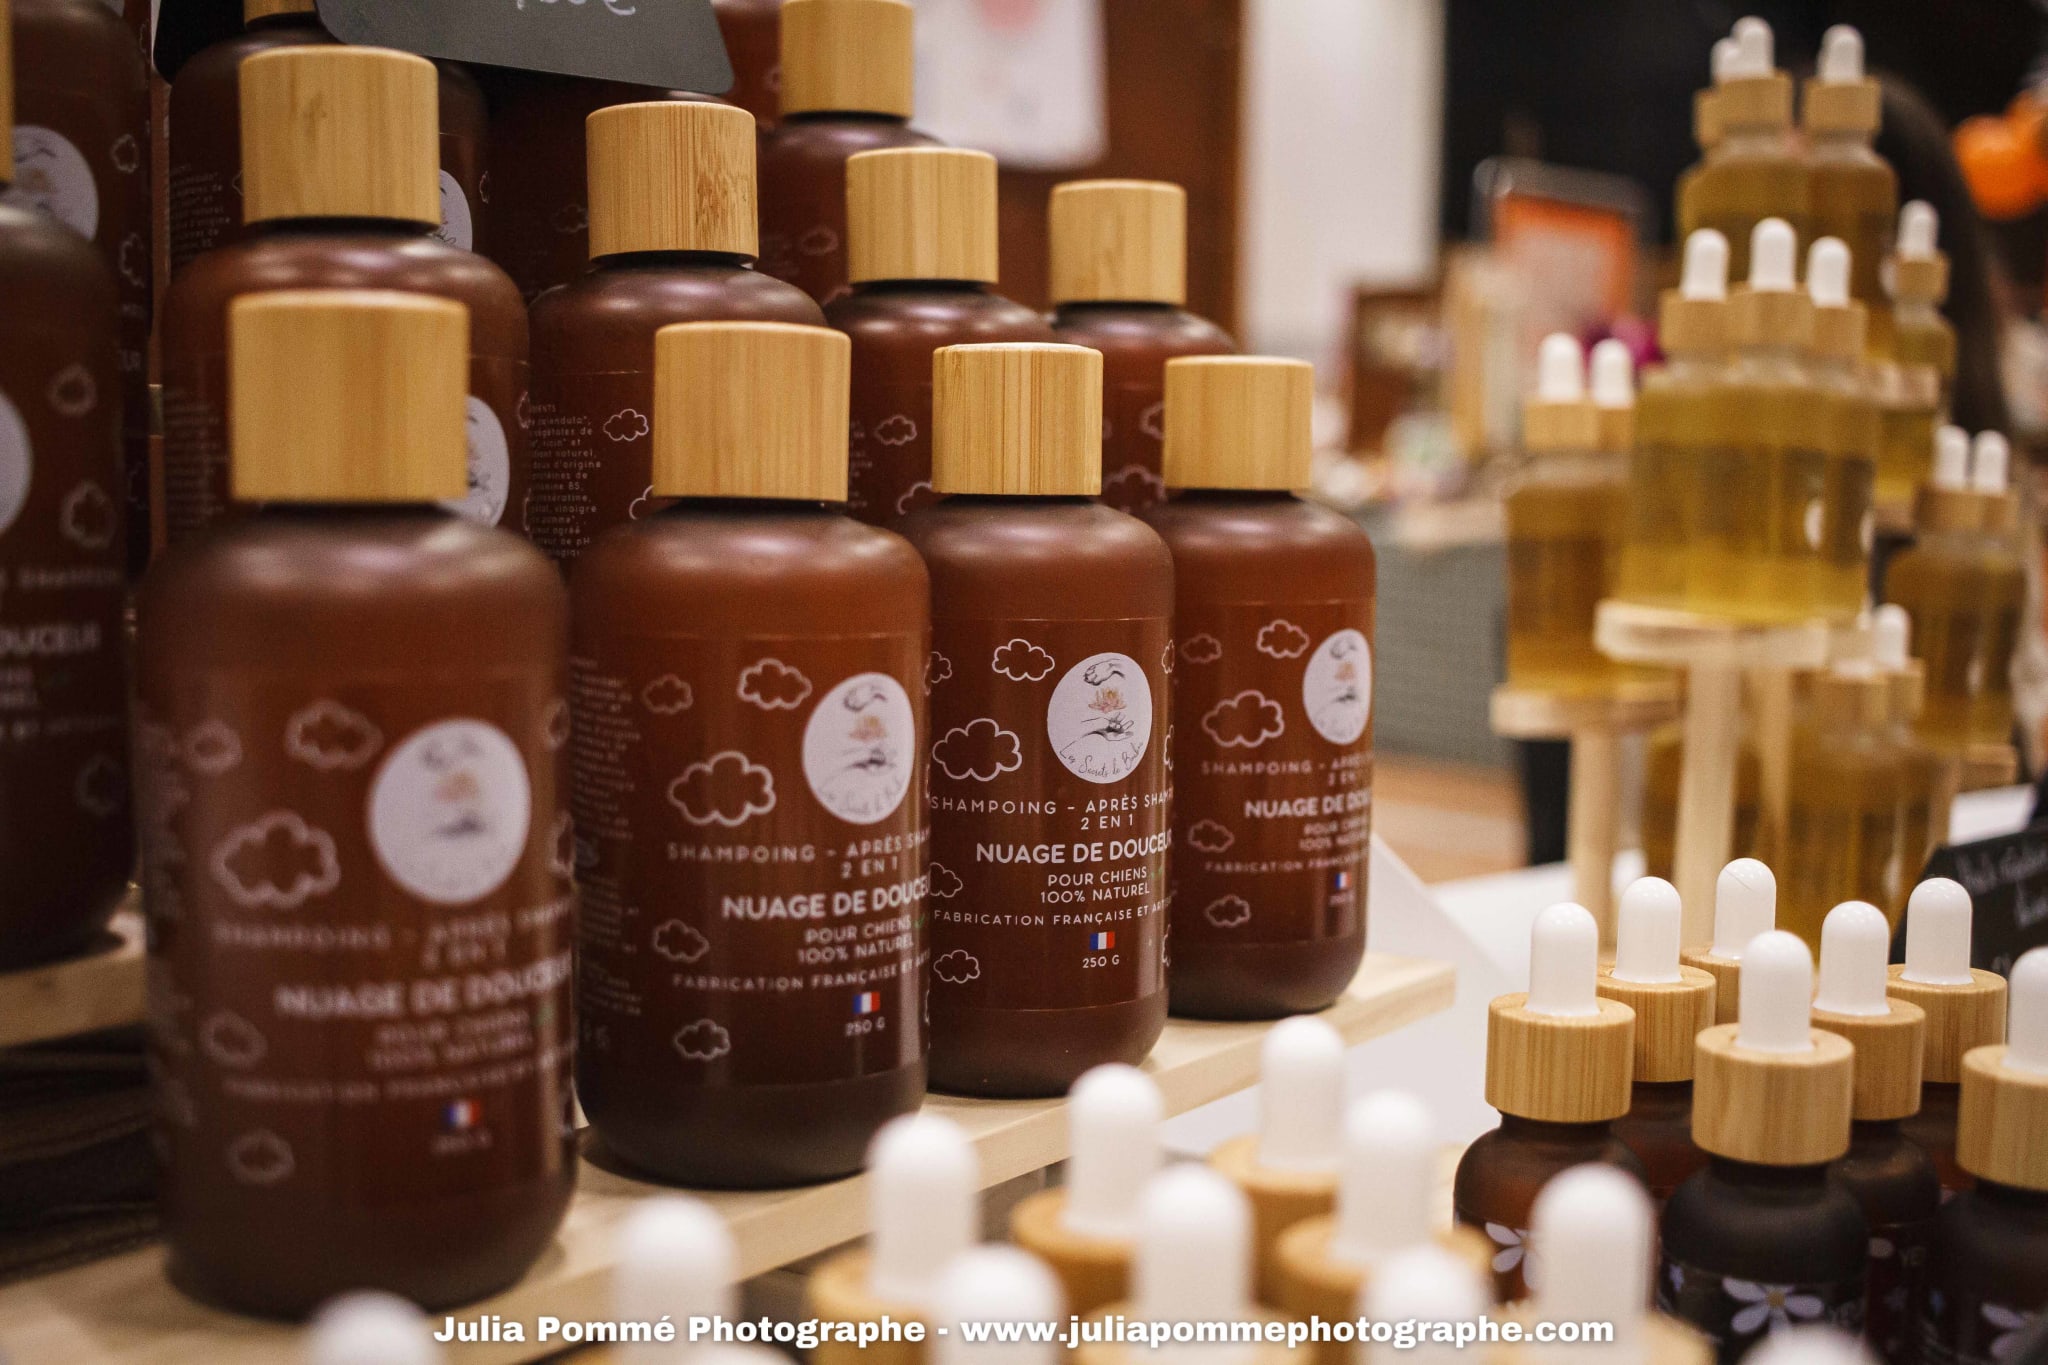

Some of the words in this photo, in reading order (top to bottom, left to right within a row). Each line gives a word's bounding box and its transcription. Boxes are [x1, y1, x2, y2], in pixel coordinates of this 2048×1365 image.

[1201, 760, 1313, 776] SHAMPOING
[931, 796, 1057, 815] SHAMPOING
[1085, 794, 1138, 813] APRÈS
[1245, 797, 1318, 818] NUAGE
[1081, 817, 1089, 830] 2
[1100, 815, 1121, 829] EN
[1128, 814, 1134, 826] 1
[667, 842, 816, 863] SHAMPOING
[976, 842, 1066, 864] NUAGE
[1073, 842, 1103, 863] DE
[861, 858, 885, 876] EN
[1048, 872, 1094, 887] POUR
[1100, 866, 1148, 884] CHIENS
[1041, 889, 1085, 904] 100%
[1093, 882, 1150, 901] NATUREL
[722, 892, 826, 920] NUAGE
[833, 889, 868, 916] DE
[934, 909, 1044, 926] FABRICATION
[1053, 908, 1133, 926] FRANÇAISE
[1137, 905, 1149, 917] ET
[805, 925, 857, 943] POUR
[863, 914, 912, 938] CHIENS
[798, 945, 848, 964] 100%
[1082, 955, 1107, 969] 250
[1112, 954, 1120, 966] G
[672, 974, 804, 992] FABRICATION
